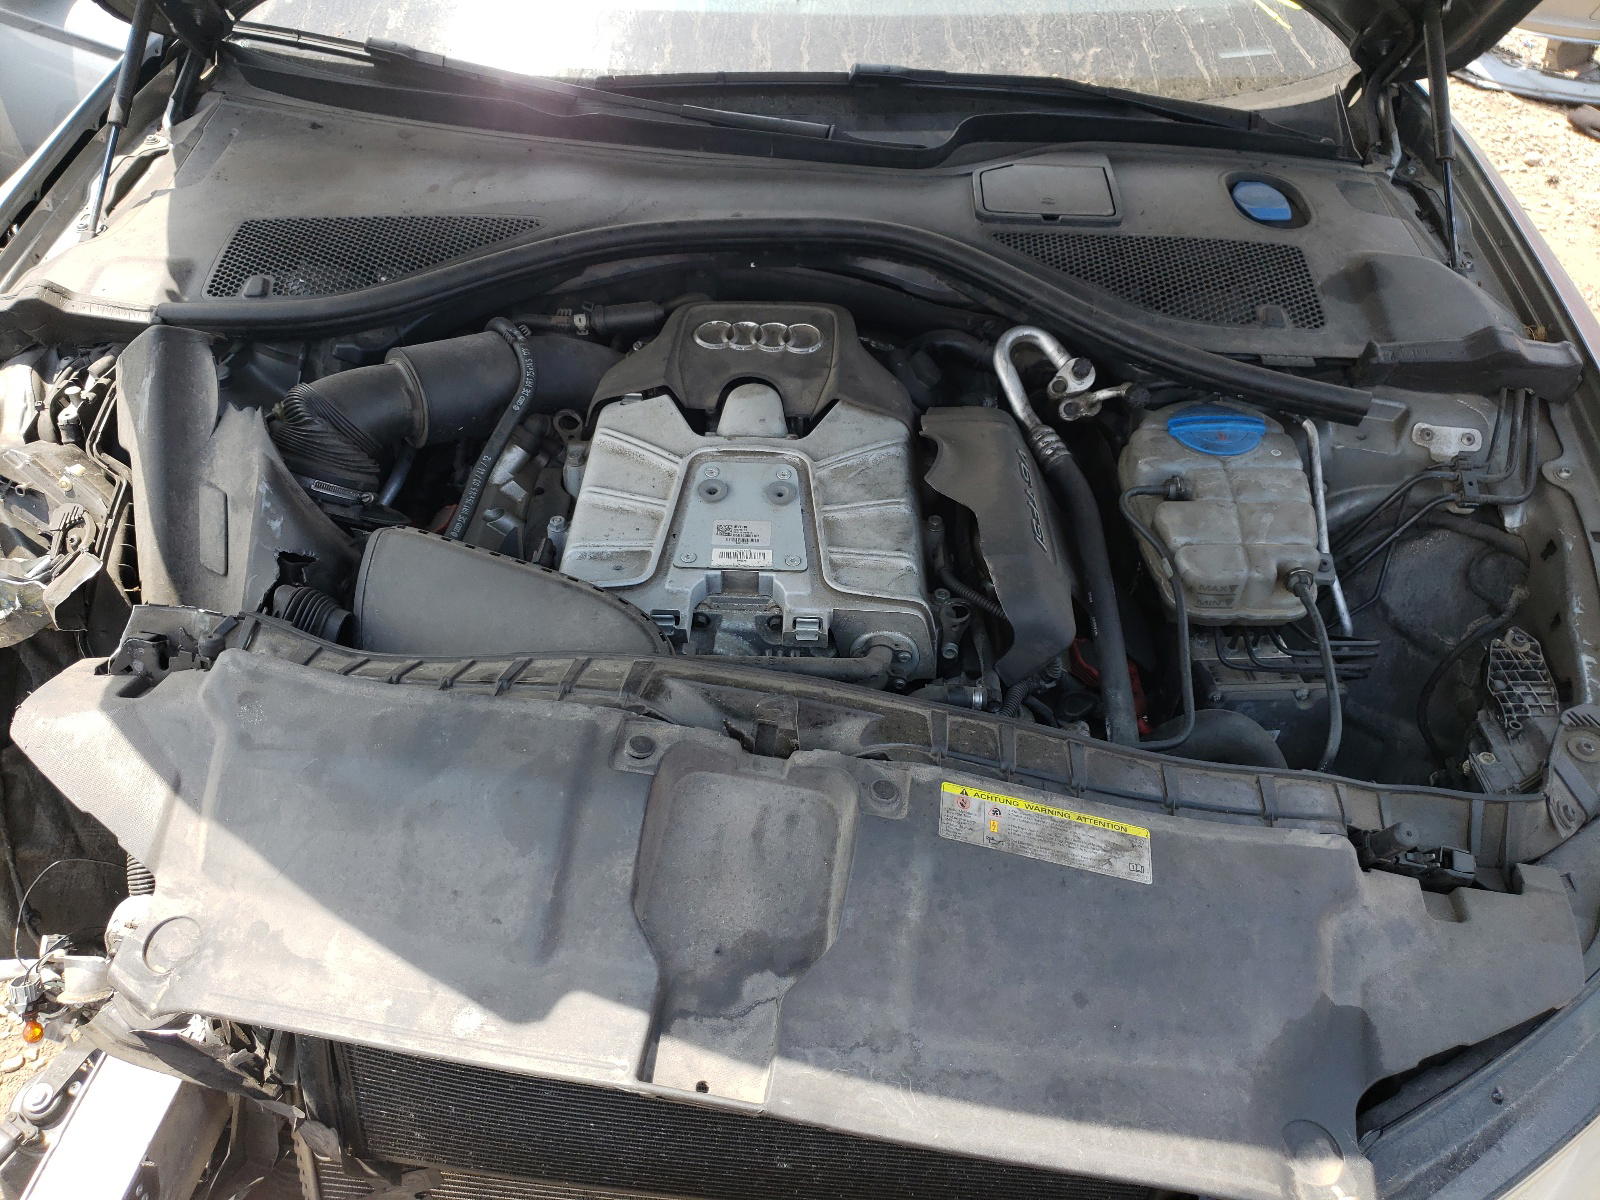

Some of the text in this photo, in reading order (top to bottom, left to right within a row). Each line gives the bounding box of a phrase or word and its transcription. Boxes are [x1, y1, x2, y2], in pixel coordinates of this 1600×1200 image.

[1199, 585, 1229, 593] MAX
[1197, 599, 1225, 607] MIN
[973, 792, 1128, 832] ACHTUNG WARNING ATTENTION
